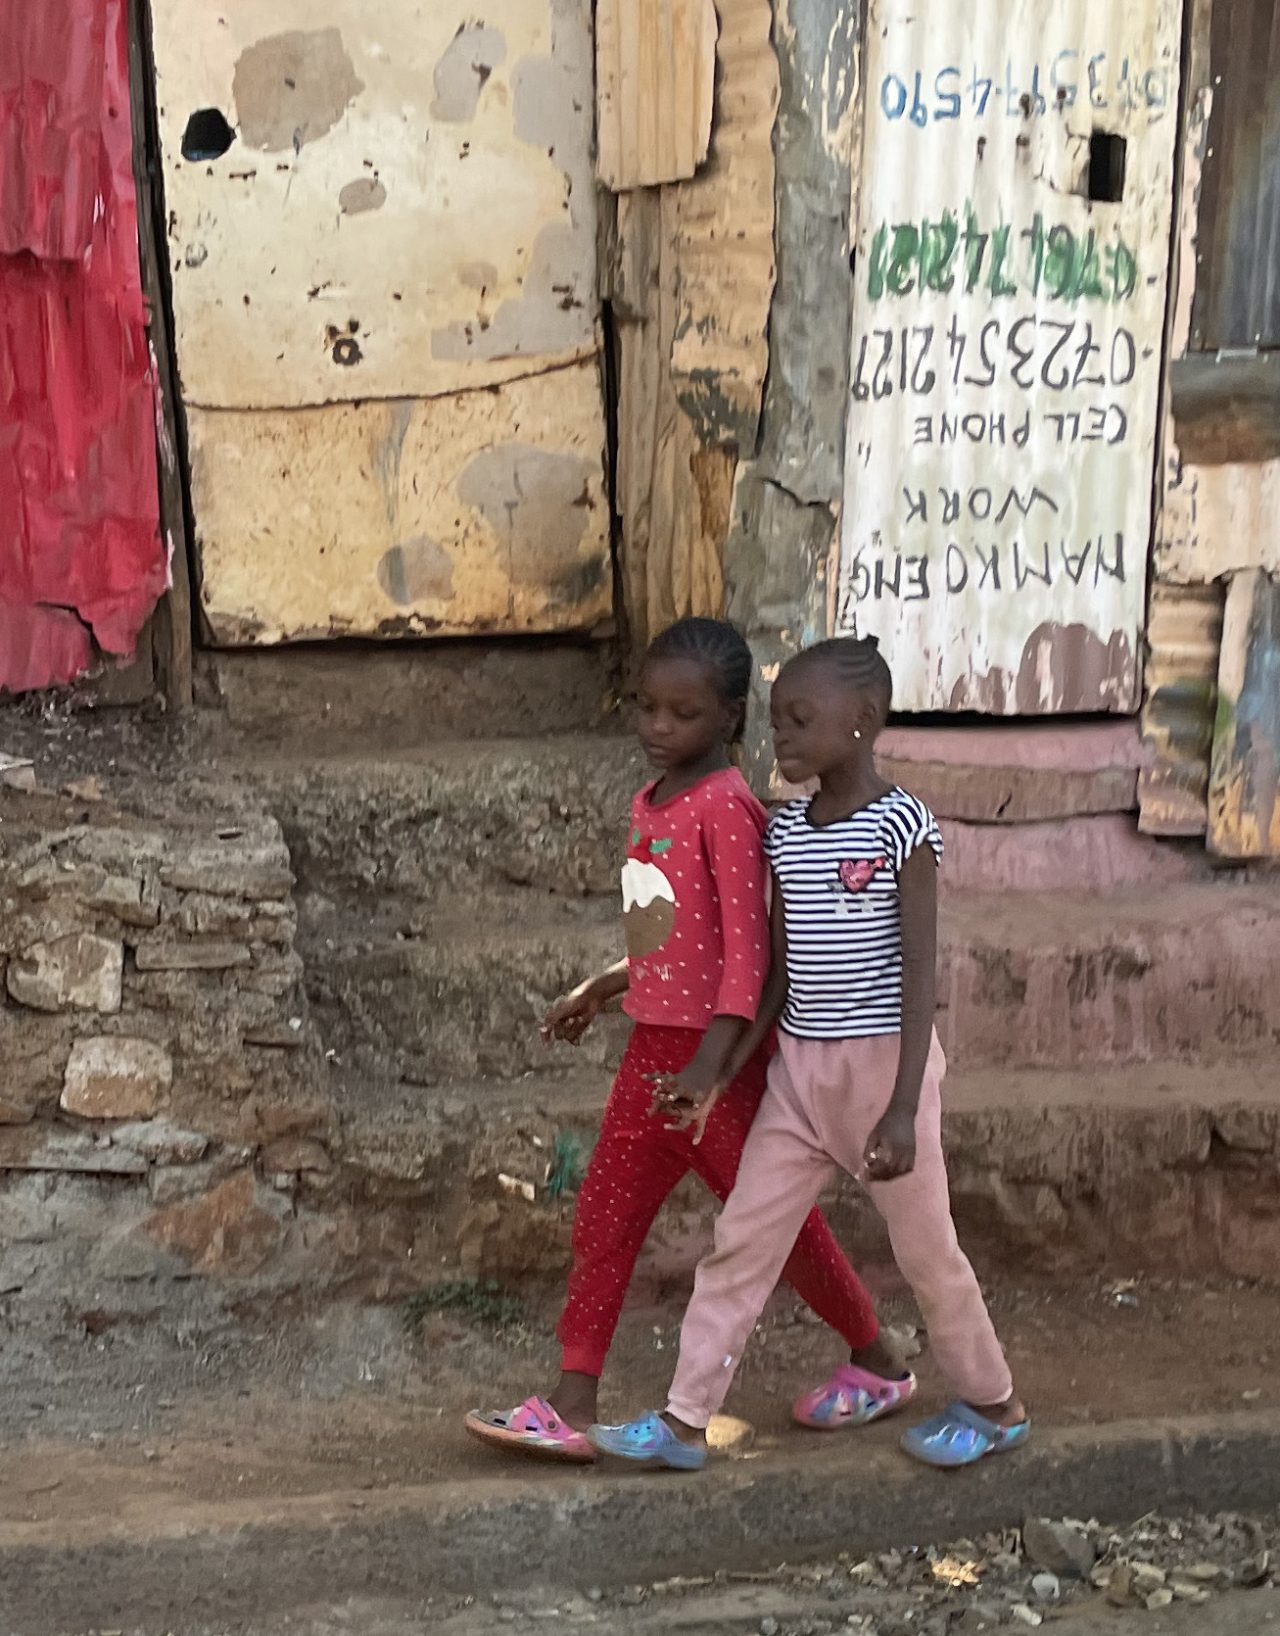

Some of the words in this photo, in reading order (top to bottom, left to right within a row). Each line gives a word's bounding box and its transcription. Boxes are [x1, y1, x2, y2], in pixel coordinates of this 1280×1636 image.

[913, 408, 1030, 448] PHONE
[1043, 402, 1127, 446] CELL
[903, 486, 1058, 526] WORK
